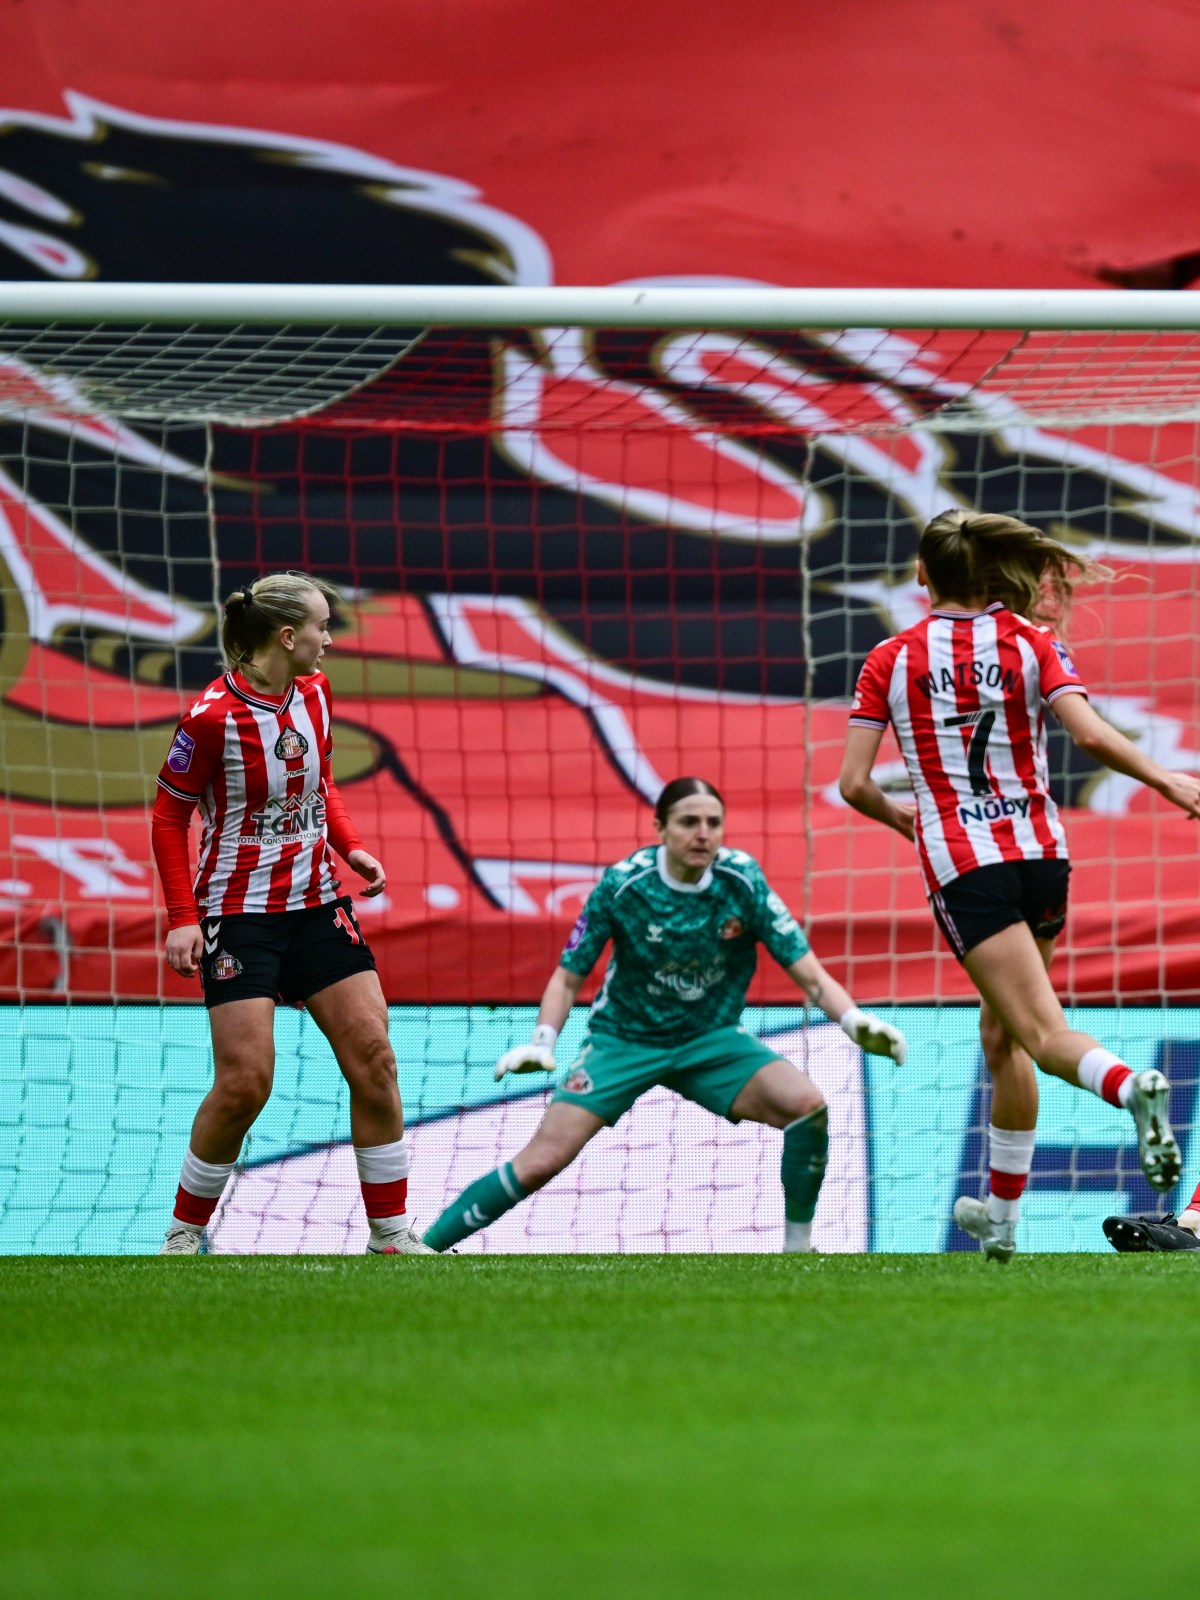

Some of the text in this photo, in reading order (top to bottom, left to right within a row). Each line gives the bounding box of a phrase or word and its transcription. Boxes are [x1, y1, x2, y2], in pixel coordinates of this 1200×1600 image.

[915, 661, 1020, 699] WATSON
[943, 710, 996, 797] 7
[252, 804, 325, 837] TCNE
[237, 837, 261, 845] TOTAL
[262, 831, 317, 846] CONSTRUCTION
